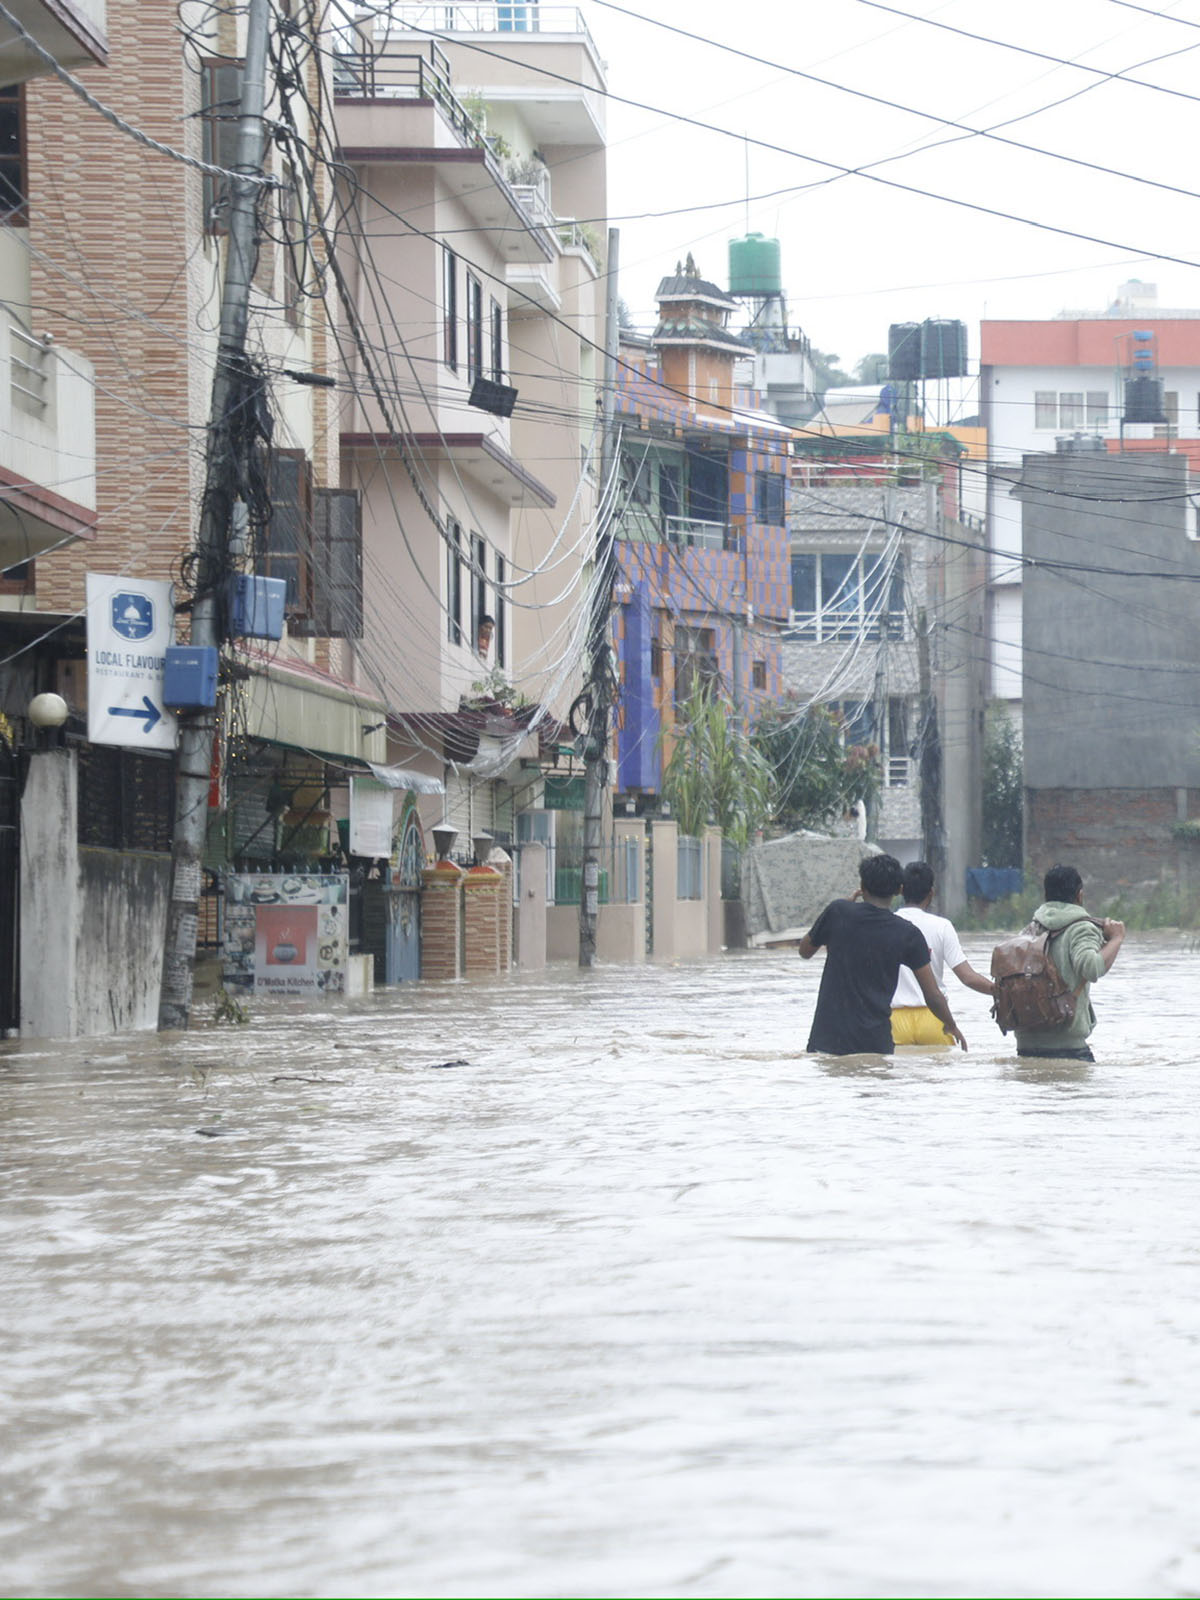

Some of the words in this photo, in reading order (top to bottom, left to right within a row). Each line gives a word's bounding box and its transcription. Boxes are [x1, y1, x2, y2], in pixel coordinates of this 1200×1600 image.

[96, 651, 122, 666] LOCAL
[126, 656, 166, 671] FLAVOUR
[96, 668, 145, 680] RESTAURANT
